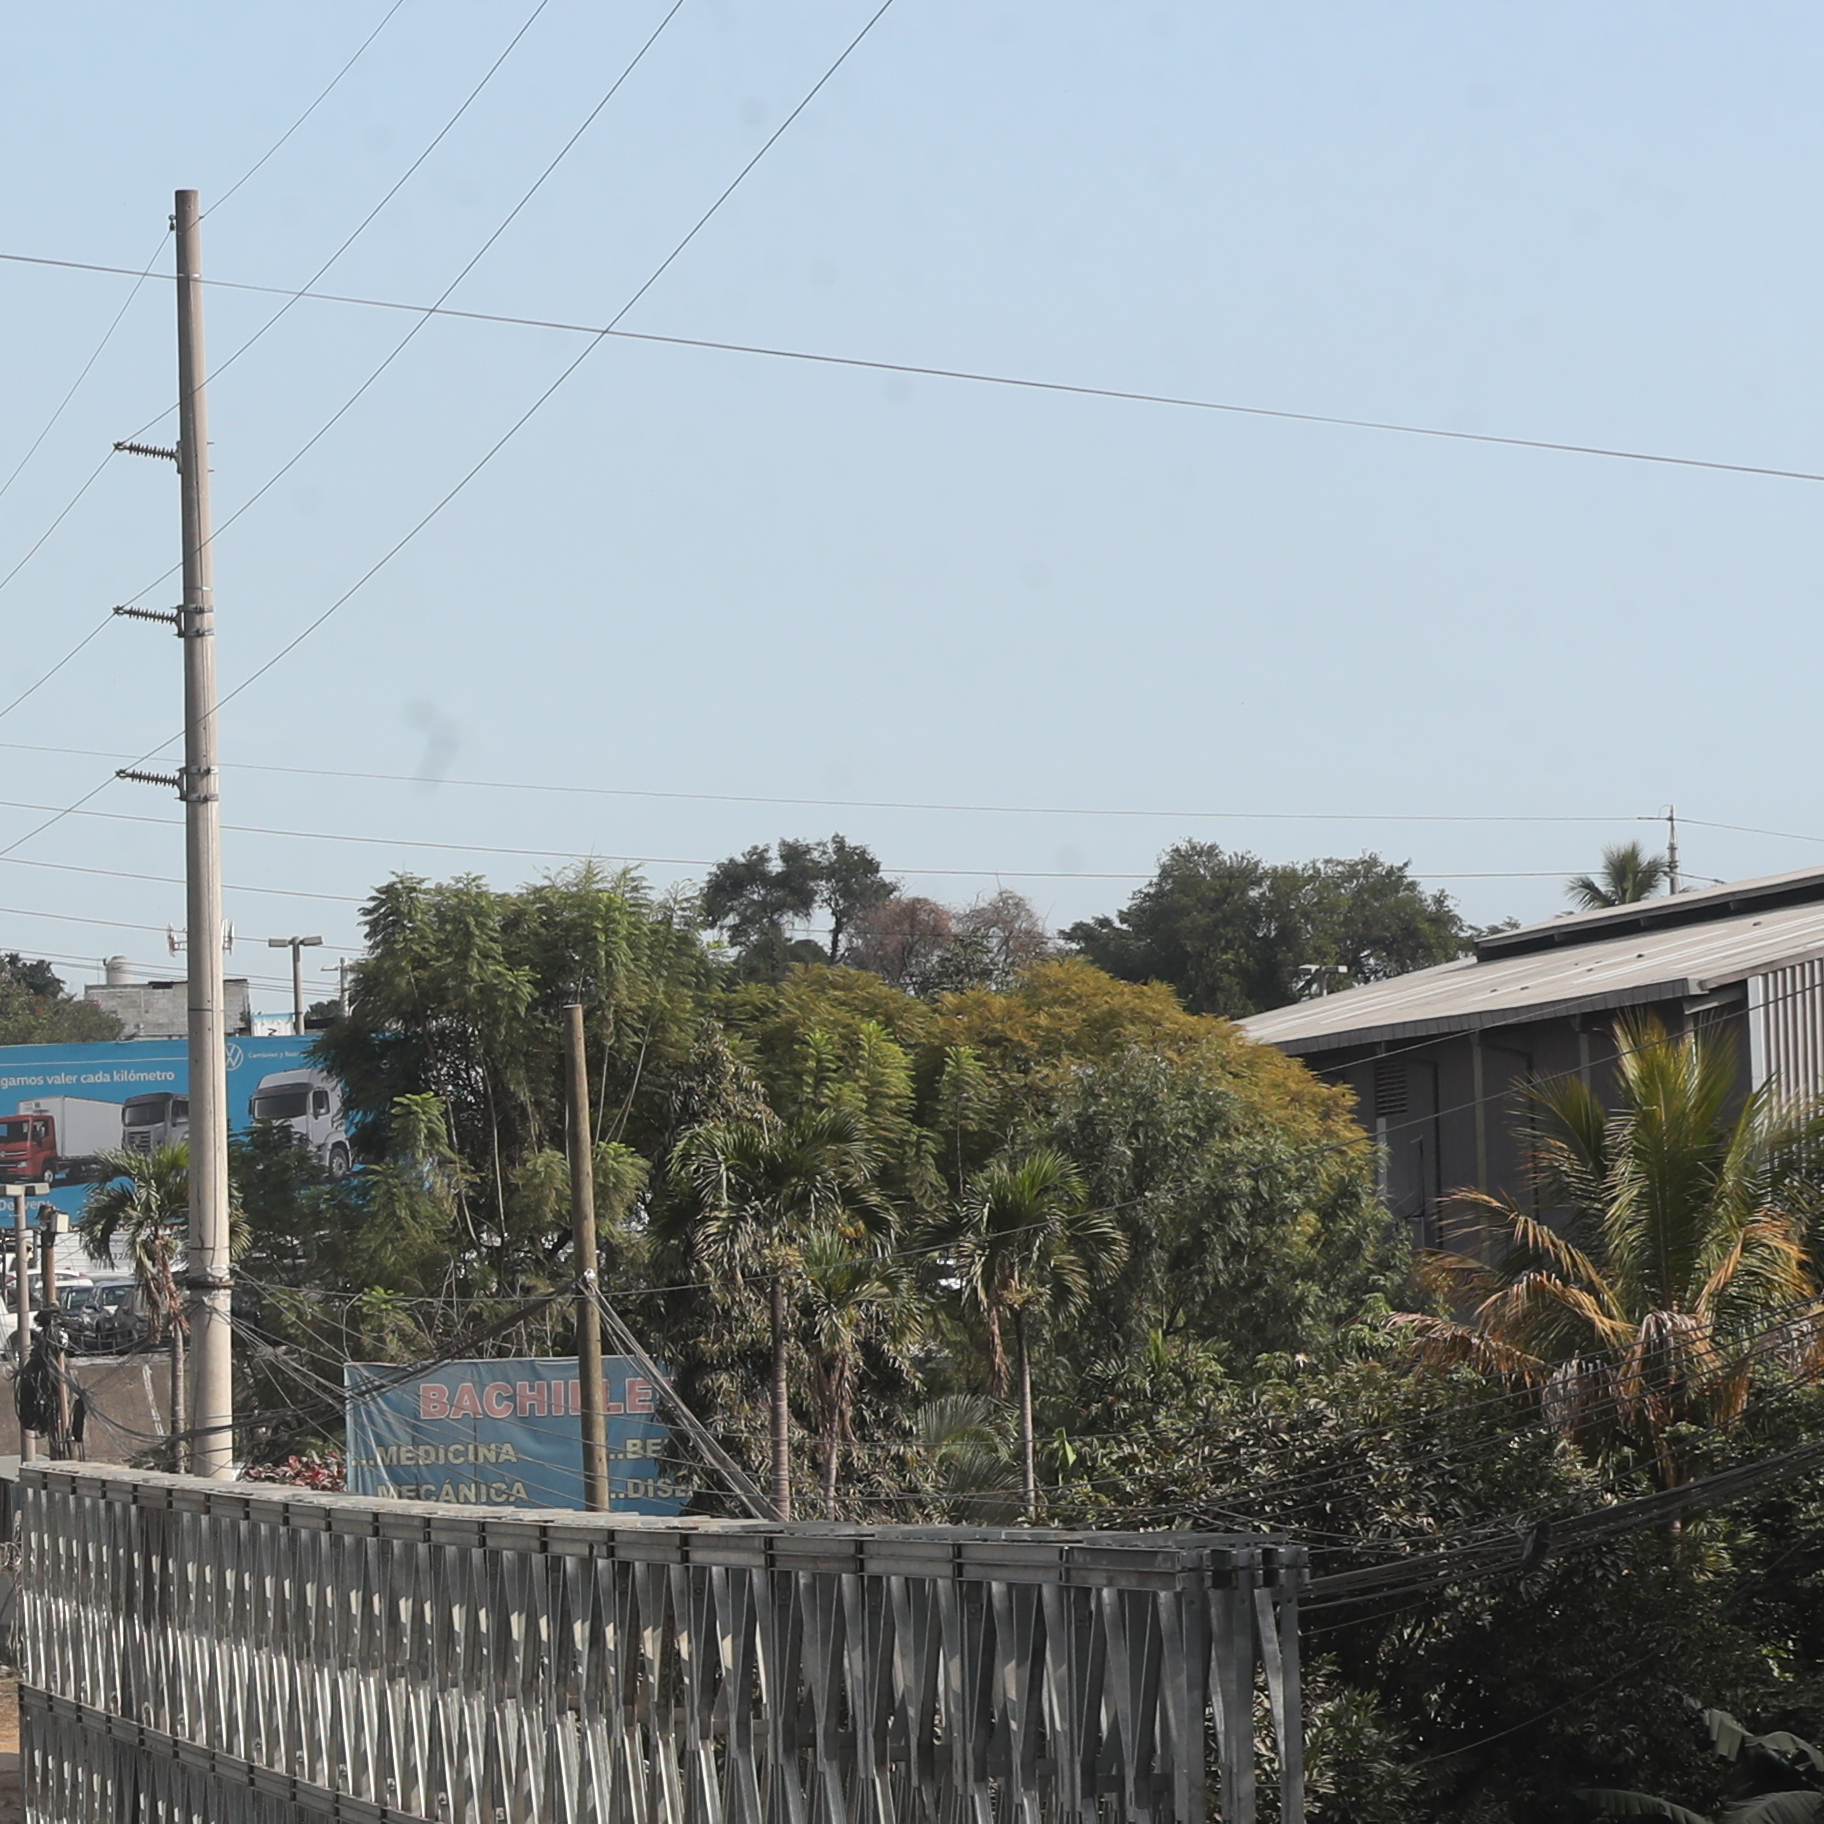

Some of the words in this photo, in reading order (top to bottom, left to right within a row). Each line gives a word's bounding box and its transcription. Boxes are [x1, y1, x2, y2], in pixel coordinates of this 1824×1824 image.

[45, 1073, 77, 1085] valer
[80, 1071, 112, 1084] cada
[113, 1069, 175, 1083] kilómetro
[376, 1478, 530, 1504] MECÁNICA
